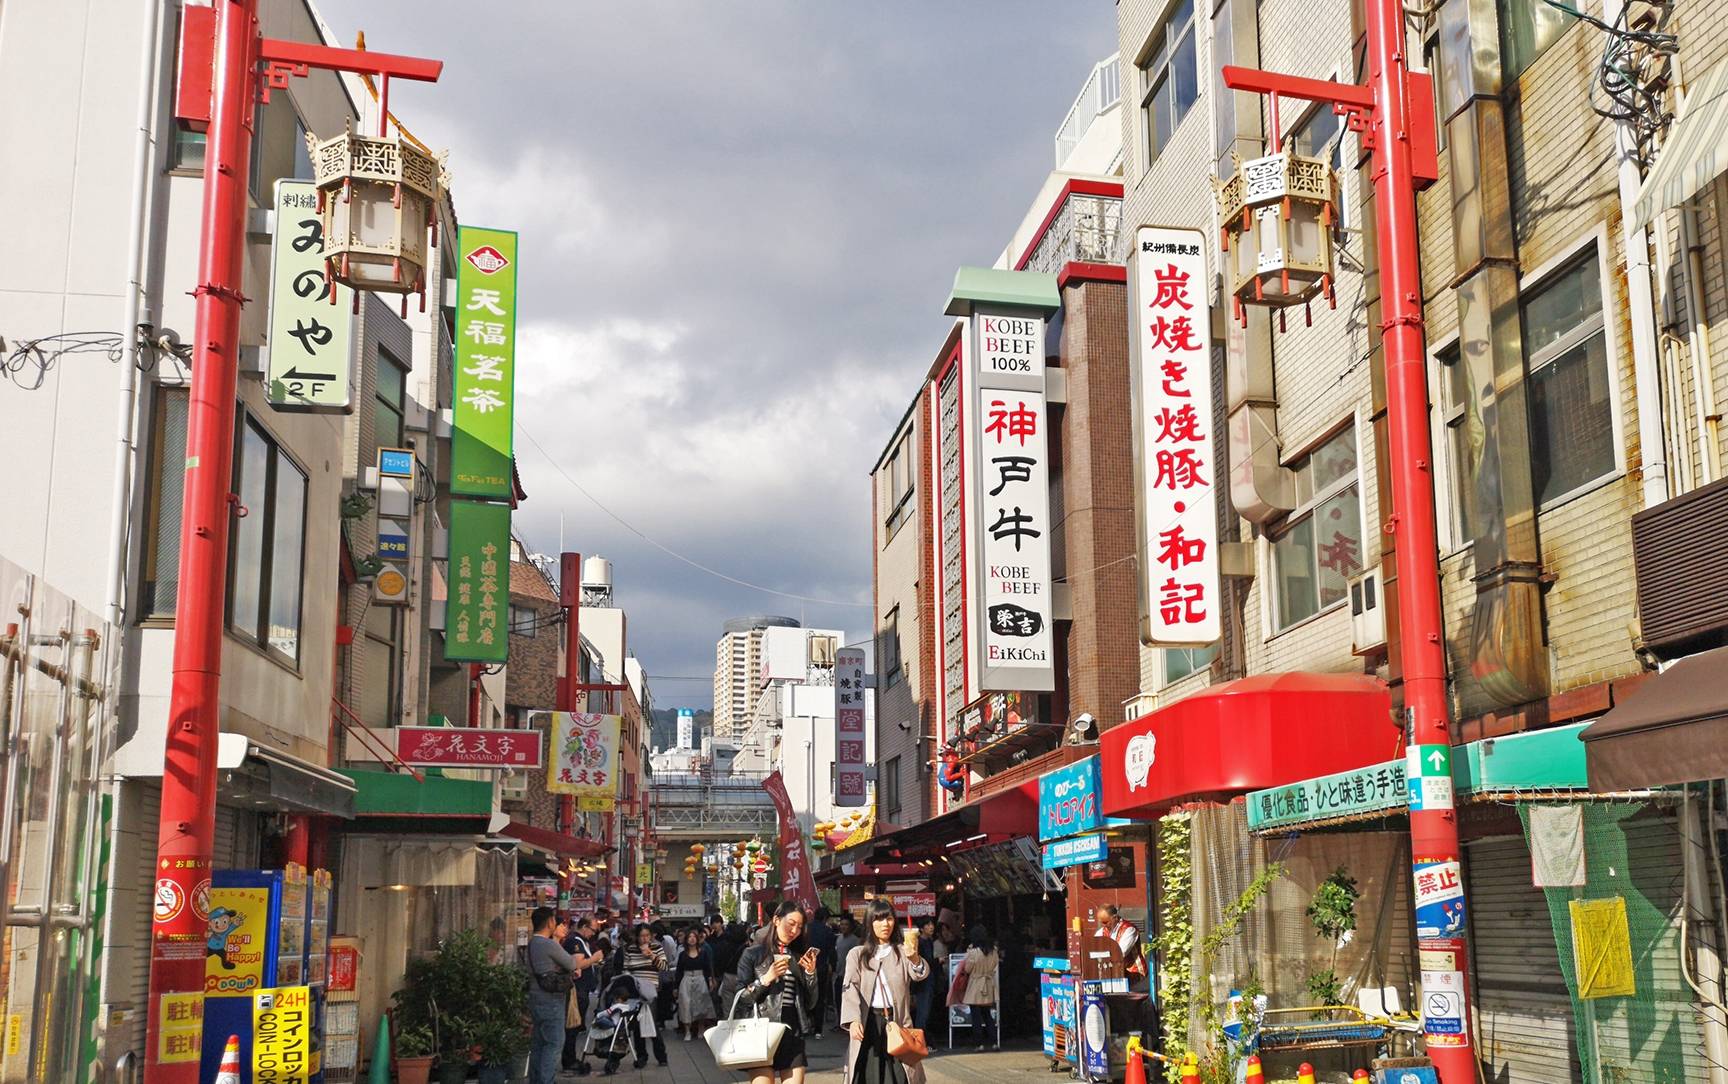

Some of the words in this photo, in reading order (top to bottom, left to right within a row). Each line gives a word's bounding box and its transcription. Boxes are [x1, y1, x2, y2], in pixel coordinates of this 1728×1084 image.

[1142, 241, 1200, 257] 紀州備長炭
[287, 219, 333, 355] みのや
[984, 318, 1035, 337] KOBE
[462, 288, 506, 415] 天福茗茶
[985, 336, 1036, 354] BEEF
[991, 357, 1031, 373] 100%
[289, 382, 325, 397] 2F
[1149, 263, 1209, 626] 炭焼き焼豚・和記
[985, 400, 1041, 552] 神戸牛
[990, 566, 1031, 579] KOBE
[1002, 581, 1042, 594] BEEF
[988, 645, 1047, 661] EiKiChi
[854, 669, 863, 702] 自家製
[446, 735, 515, 755] 花文字
[456, 753, 504, 762] HANAMOJI
[558, 768, 608, 786] 花文字
[1048, 792, 1095, 830] トルコアイス
[1417, 868, 1459, 895] 禁止
[227, 935, 251, 945] We'll
[227, 944, 240, 952] Be
[227, 952, 261, 963] Happy!
[220, 977, 255, 989] DOWN
[275, 992, 306, 1008] 24H
